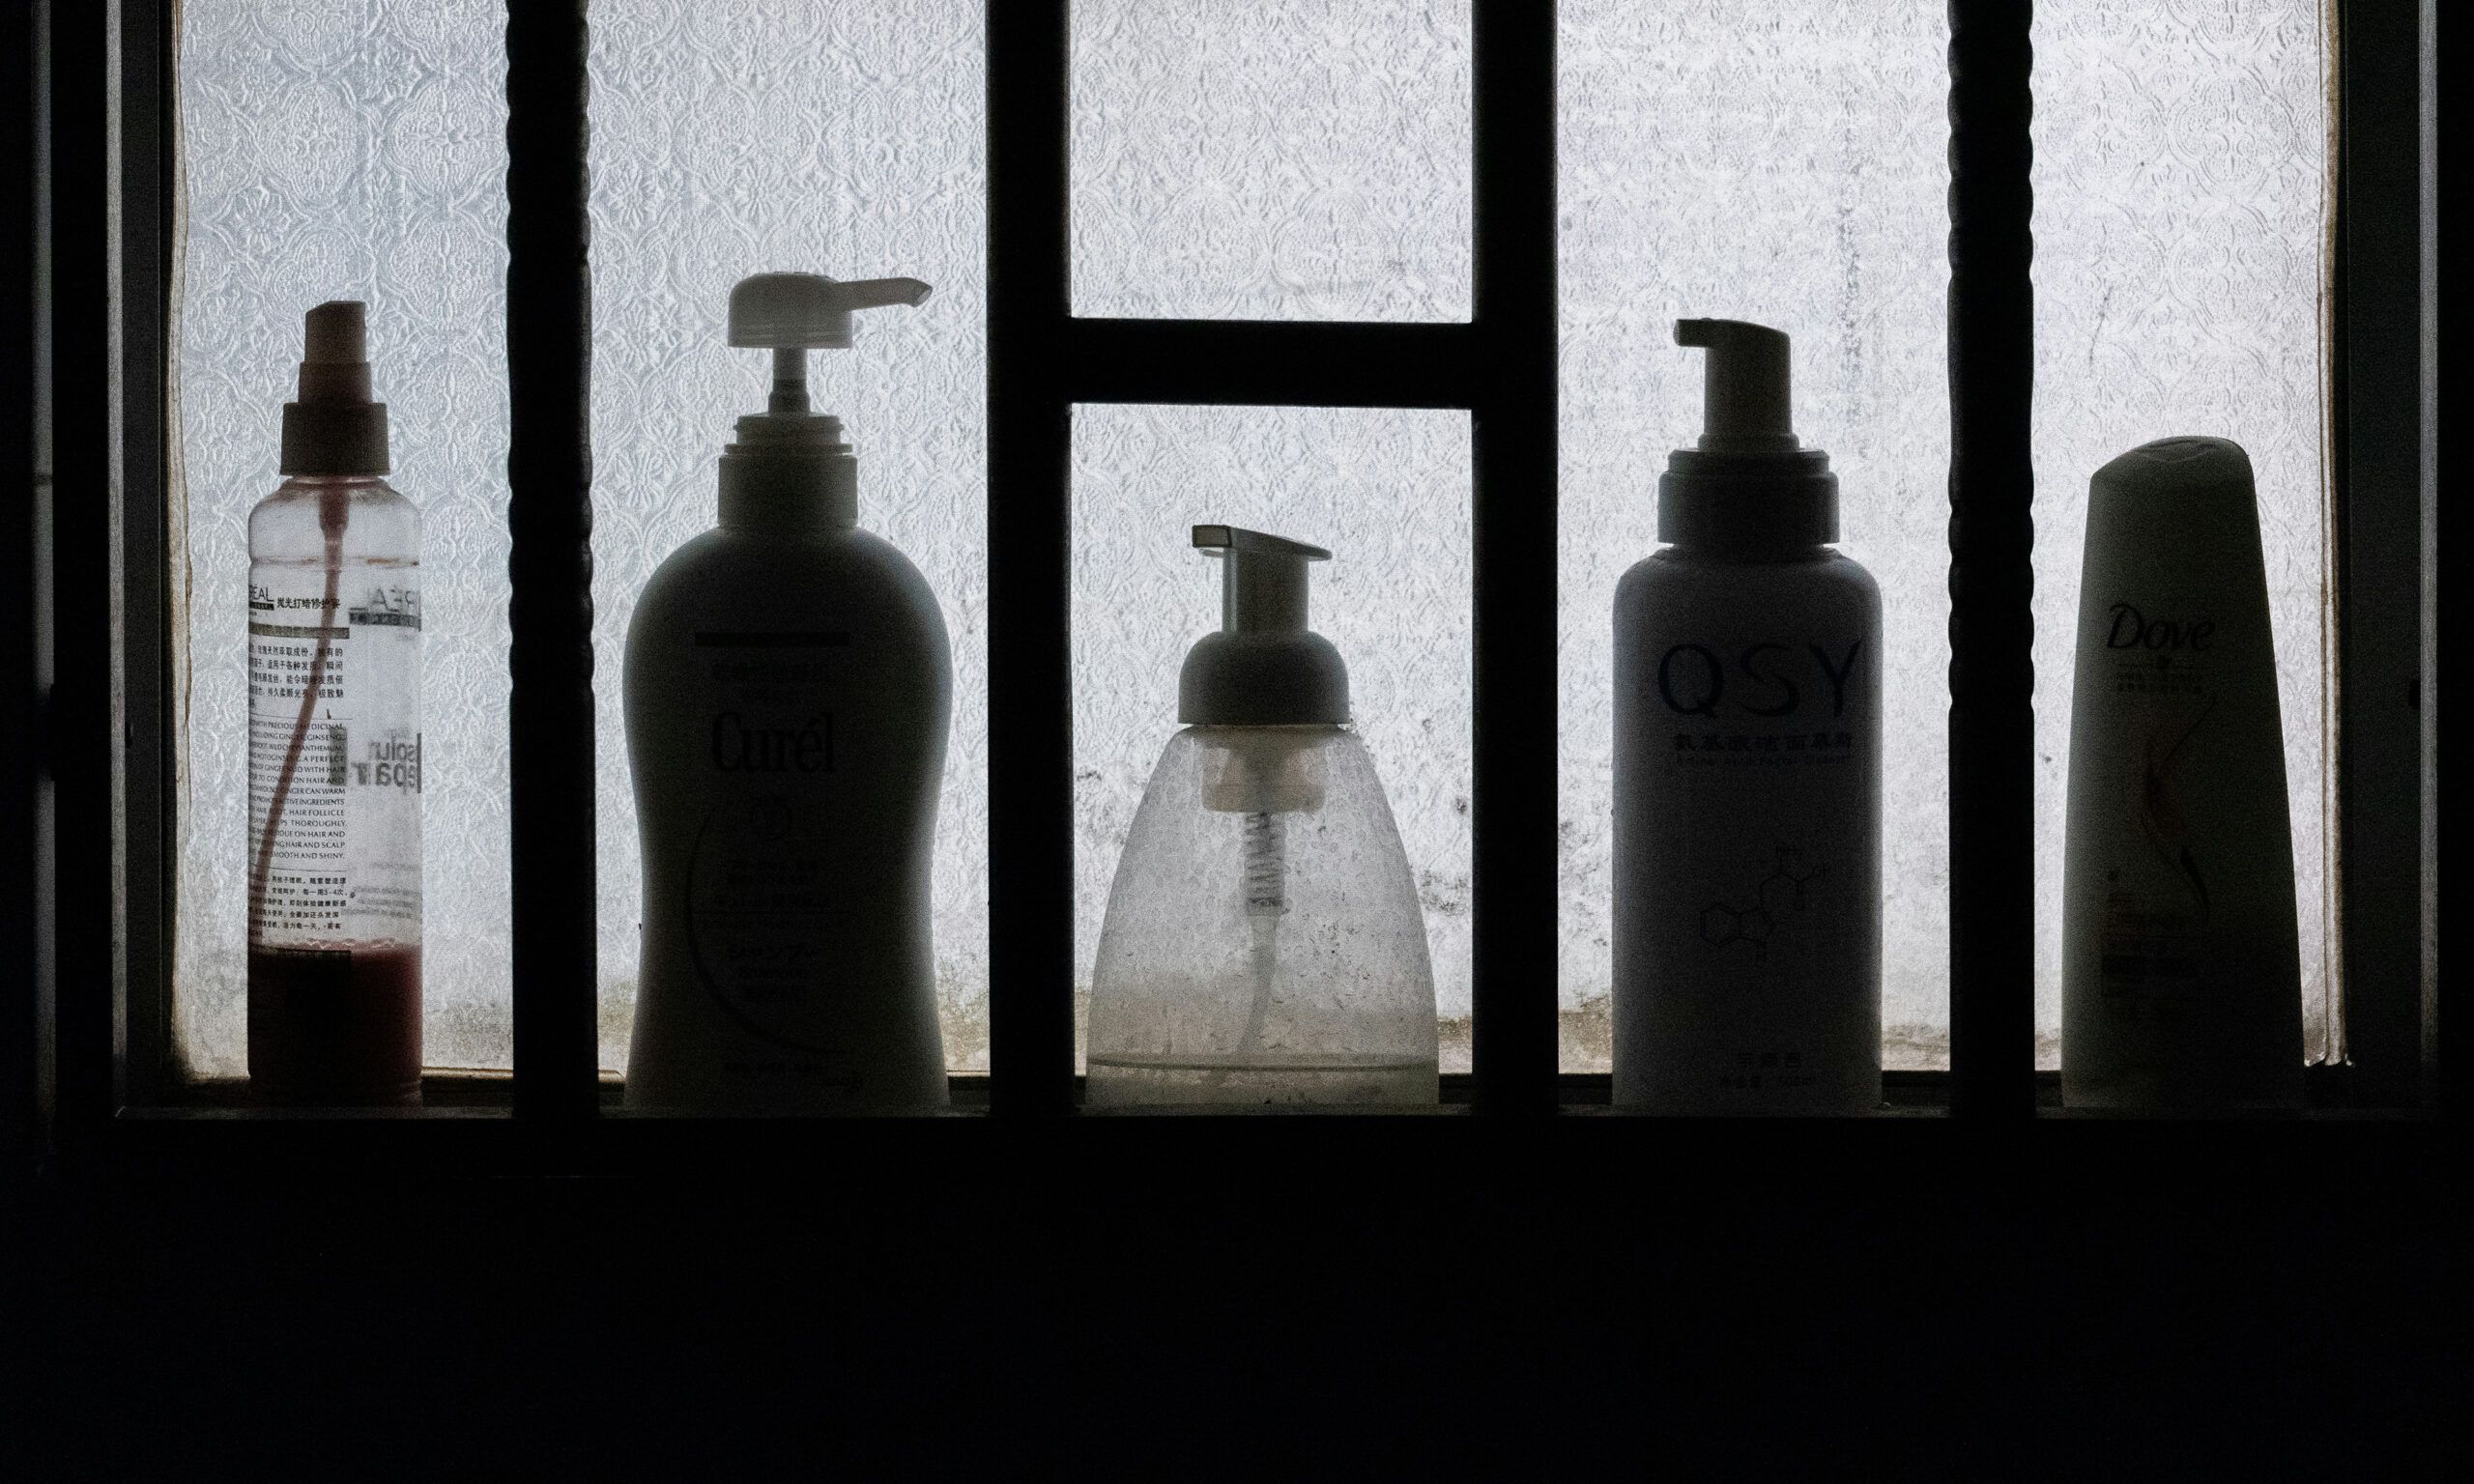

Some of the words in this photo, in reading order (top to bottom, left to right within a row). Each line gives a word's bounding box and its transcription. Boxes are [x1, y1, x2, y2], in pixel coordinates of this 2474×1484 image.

[2107, 603, 2216, 651] Dove
[1657, 640, 1860, 718] QSY
[712, 711, 832, 772] Curél
